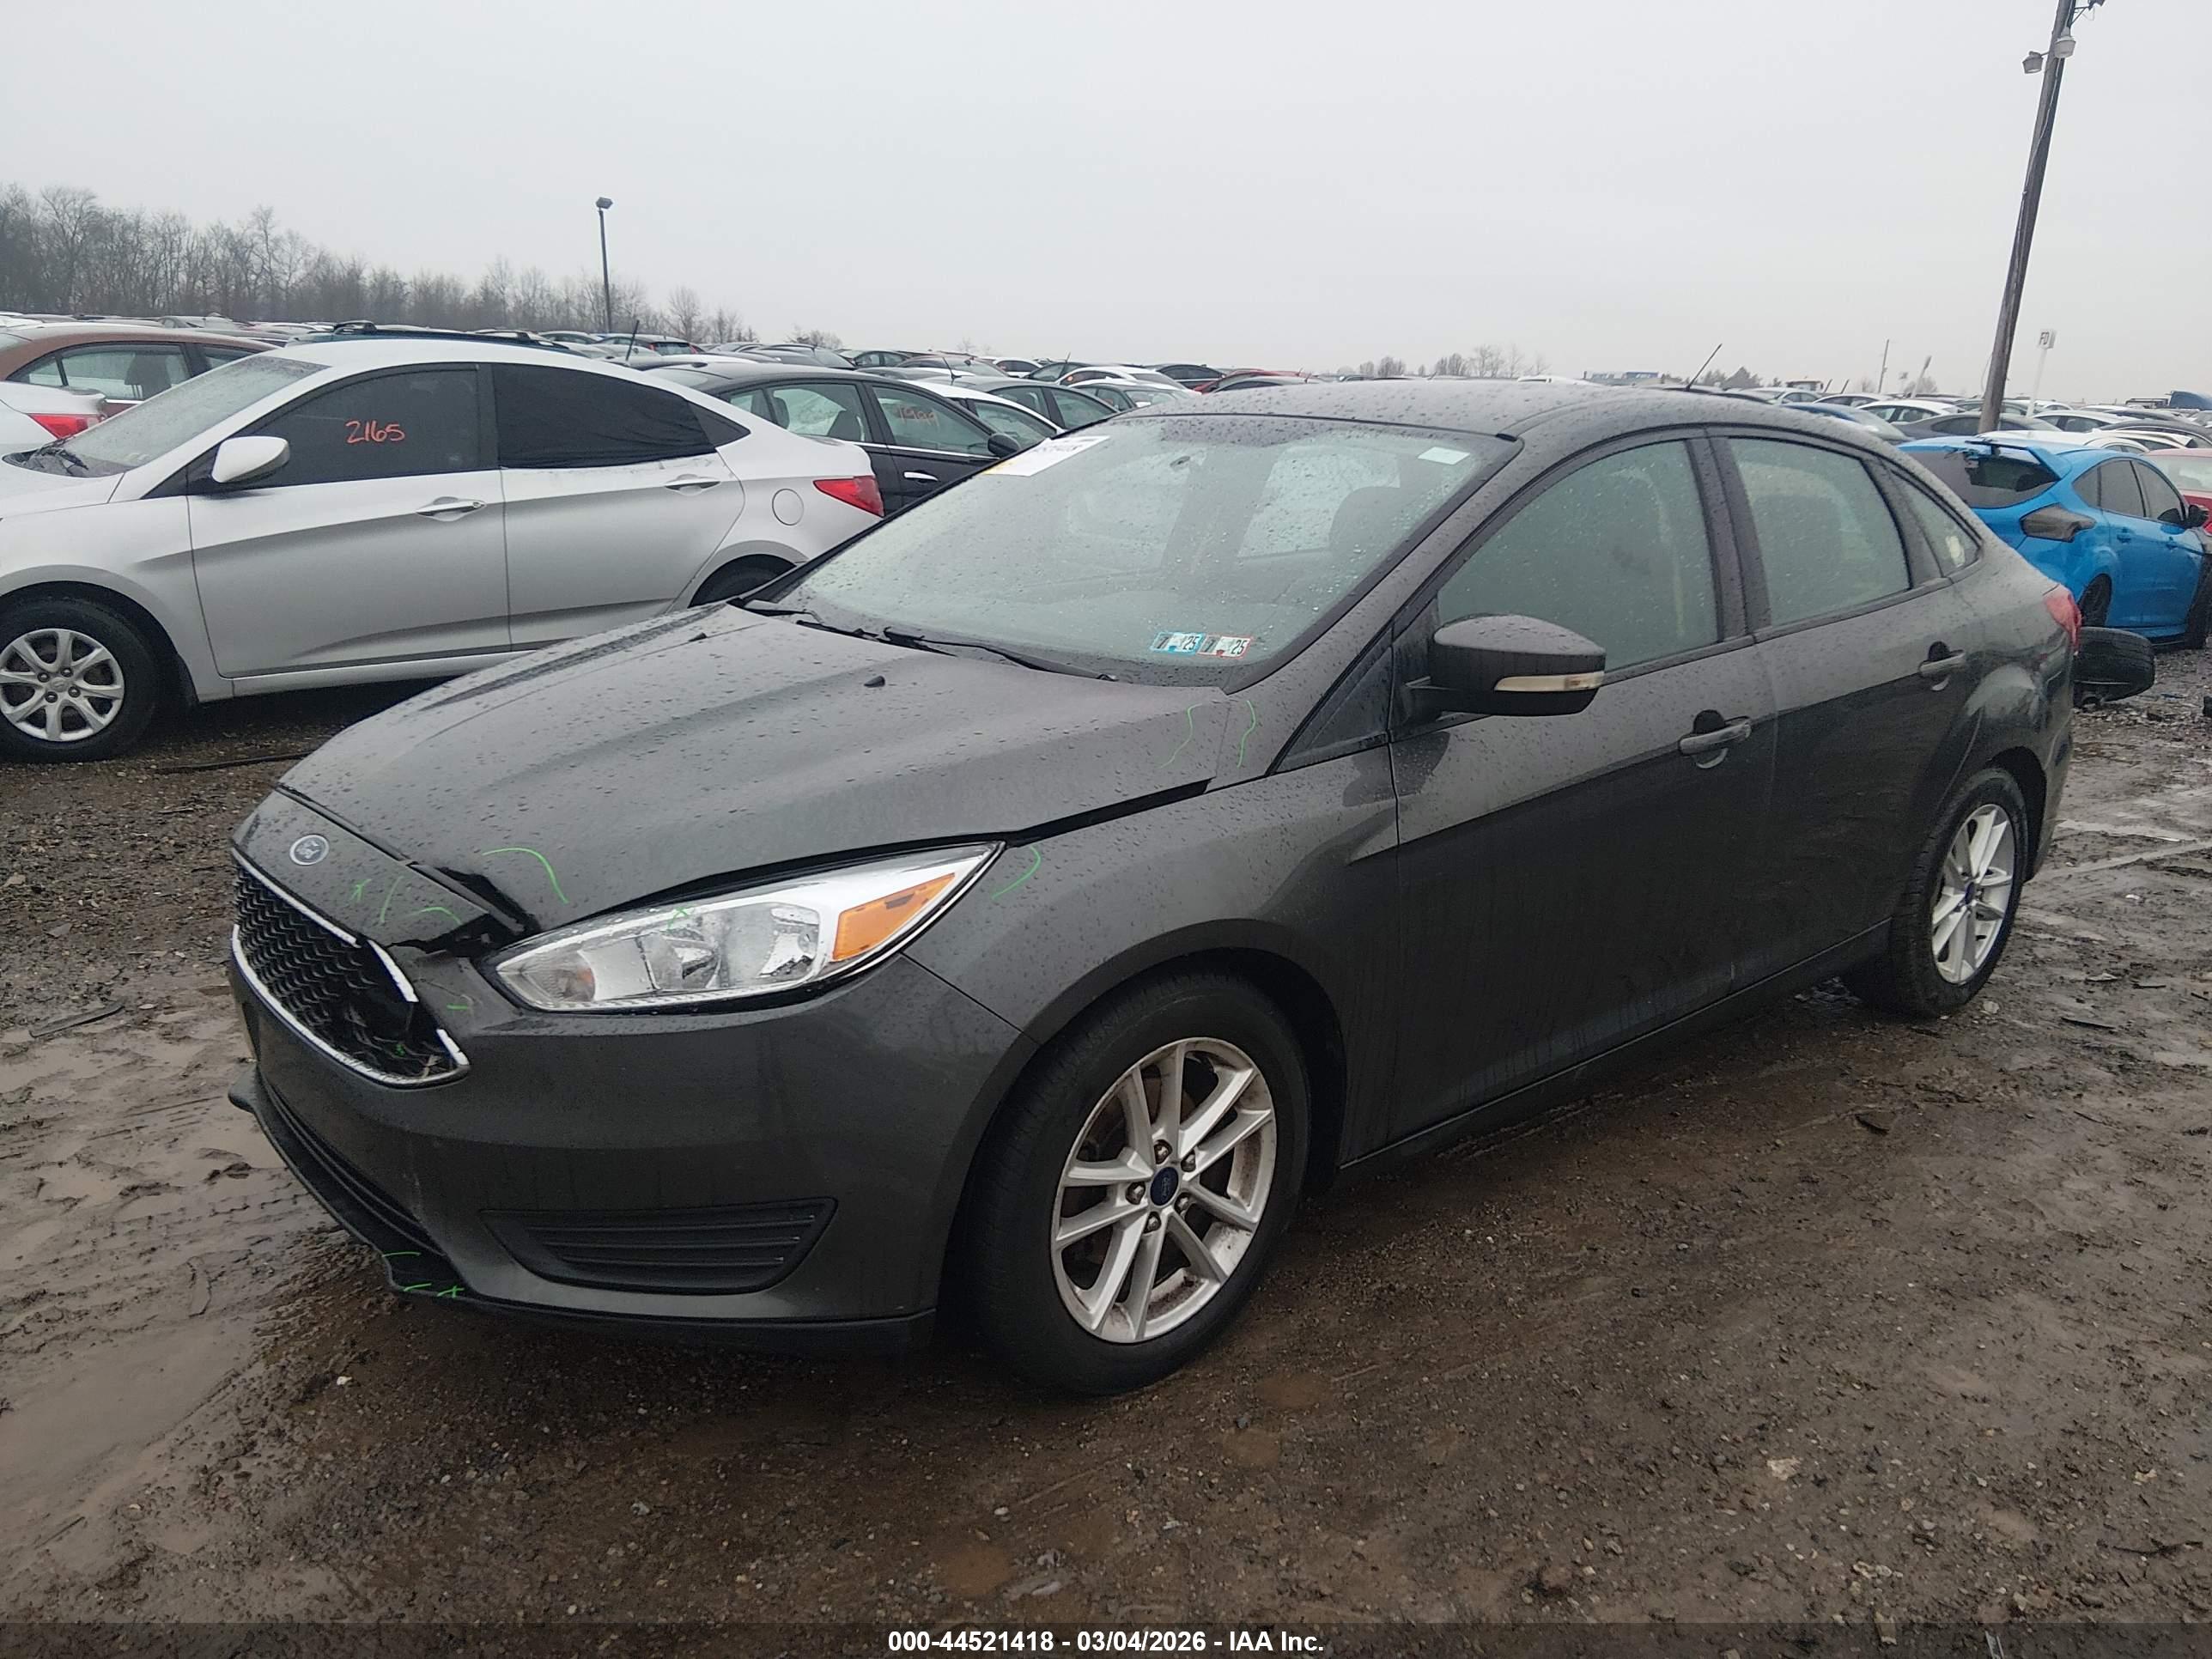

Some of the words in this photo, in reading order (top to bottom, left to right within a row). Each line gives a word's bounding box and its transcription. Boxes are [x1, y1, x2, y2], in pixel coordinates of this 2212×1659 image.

[345, 420, 405, 443] 2165
[1182, 635, 1200, 650] 25
[1231, 640, 1248, 654] 25
